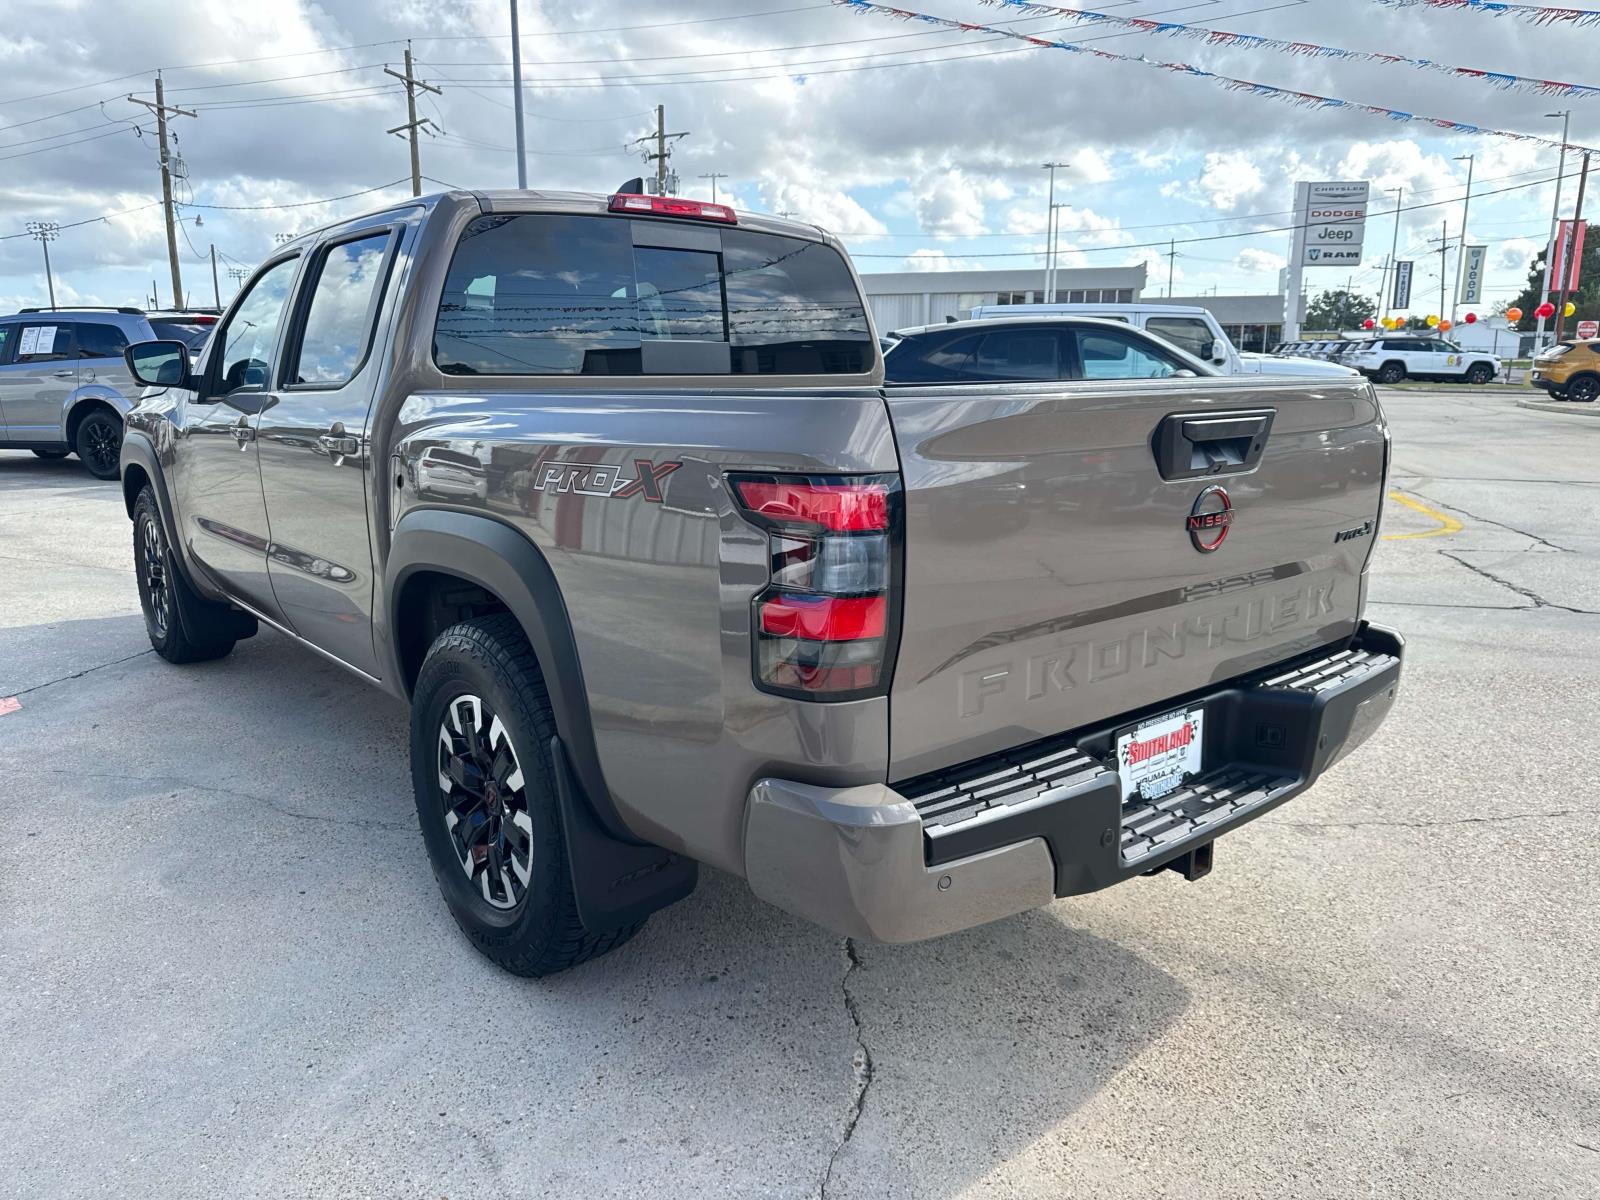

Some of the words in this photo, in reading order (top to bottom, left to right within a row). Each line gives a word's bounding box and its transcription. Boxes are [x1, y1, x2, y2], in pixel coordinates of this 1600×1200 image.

[1311, 210, 1364, 219] DODGE
[1318, 227, 1353, 241] Jeep
[1466, 259, 1479, 300] Jeep
[1189, 511, 1235, 529] NISSAN
[957, 578, 1336, 720] FRONTIER
[1128, 721, 1192, 766] SOUTHLAND
